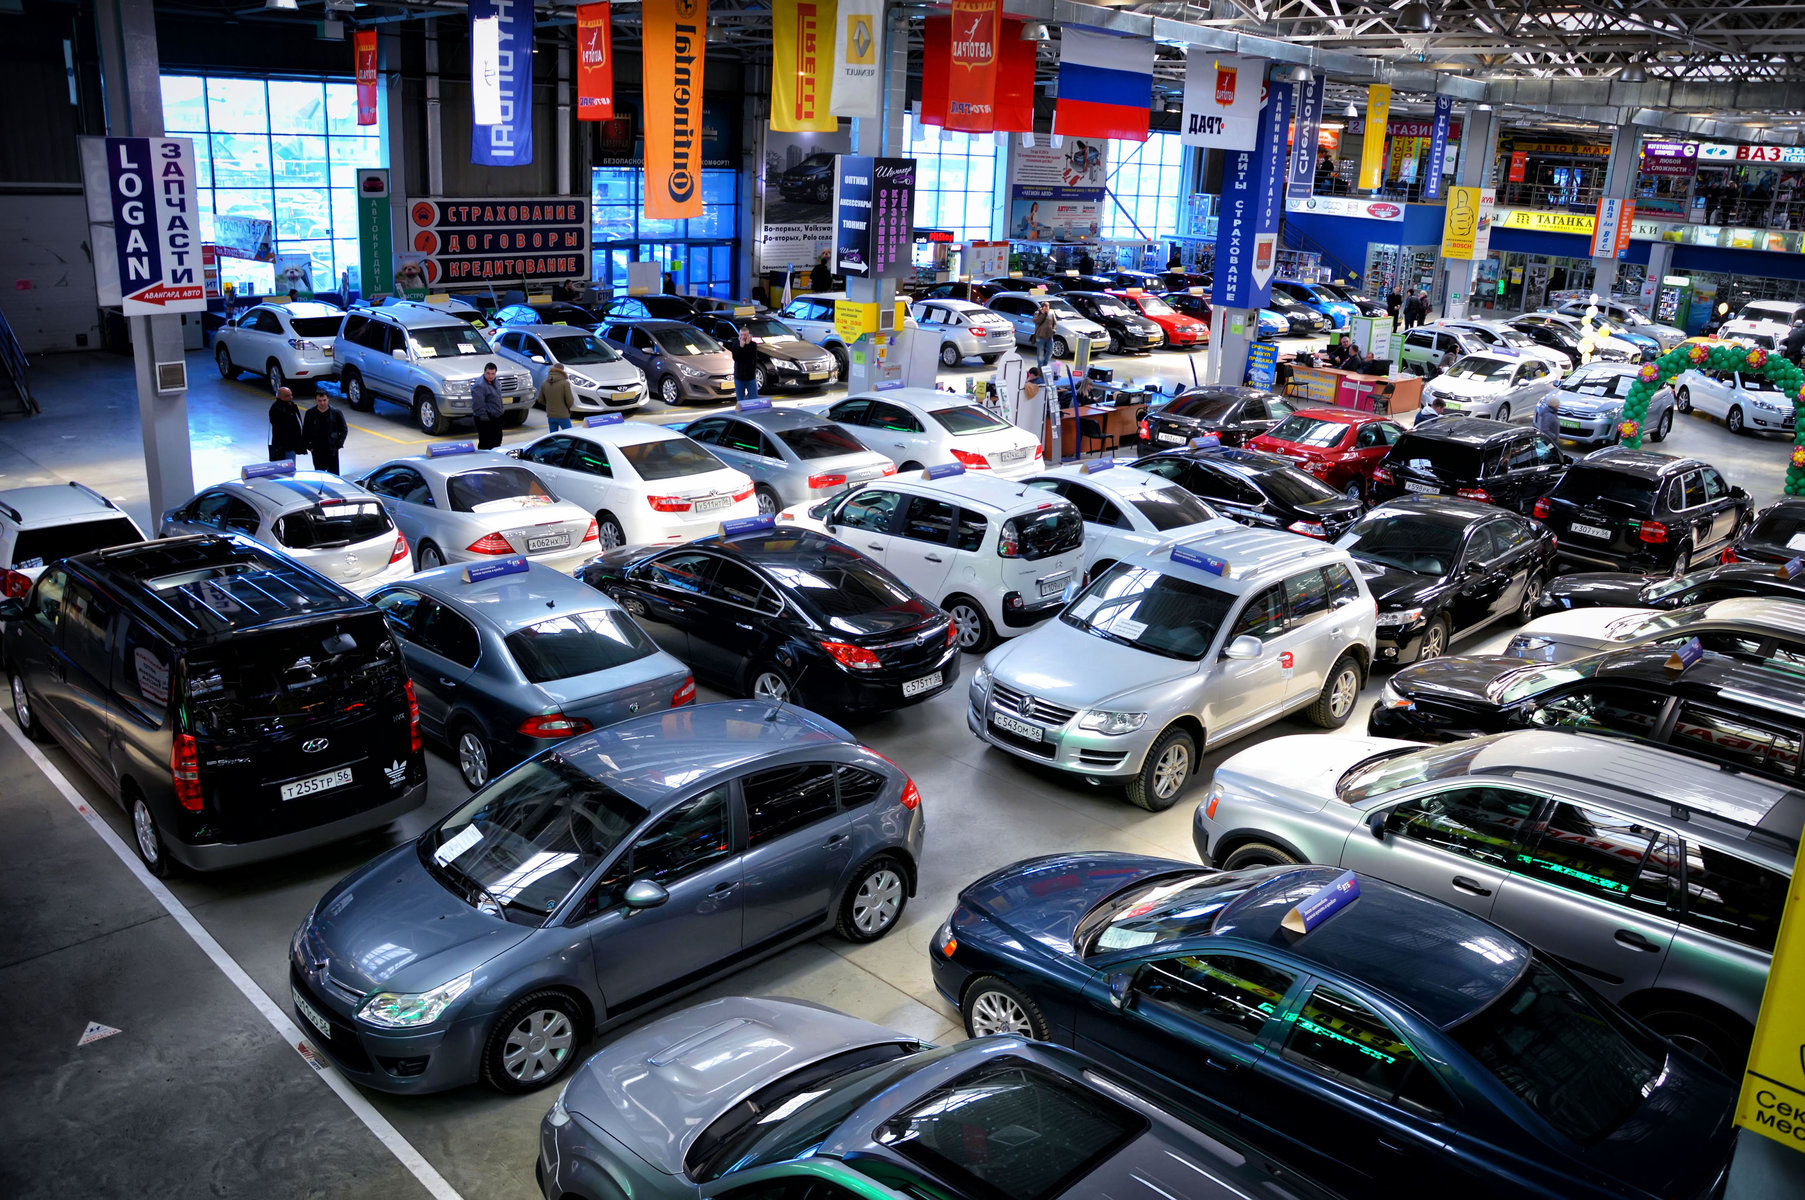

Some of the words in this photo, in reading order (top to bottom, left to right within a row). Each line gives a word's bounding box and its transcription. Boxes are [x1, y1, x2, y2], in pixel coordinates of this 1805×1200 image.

[1352, 122, 1360, 130] 2
[1265, 91, 1283, 228] АДМИНИСТРАТОР
[1736, 145, 1781, 161] ВАЗ
[1234, 153, 1249, 190] ДИТЫ
[1651, 165, 1688, 173] СЛОЖНОСТИ
[844, 175, 868, 186] ОПТИКА
[839, 198, 872, 209] АКСЕССУАРЫ
[118, 144, 150, 281] LOGAN
[161, 143, 194, 285] ЗАПЧАСТИ
[448, 205, 577, 222] СТРАХОВАНИЕ
[842, 219, 867, 231] ТЮНИНГ
[1536, 214, 1593, 228] ТАГАНКА
[448, 232, 578, 253] ДОГОВОРЫ
[802, 233, 817, 241] Polo
[371, 200, 382, 292] АВТОКРЕДИТЫ
[1226, 200, 1244, 301] СТРАХОВАНИЕ
[449, 257, 577, 278] КРЕДИТОВАНИЕ
[144, 291, 180, 299] АВАНГАРД
[532, 538, 559, 549] А062НХ
[906, 678, 933, 693] С575ТТ
[997, 715, 1029, 737] С543ОМ
[1031, 726, 1041, 738] 56
[287, 777, 334, 798] Т255ТР
[337, 770, 349, 781] 56
[389, 775, 406, 785] adidas
